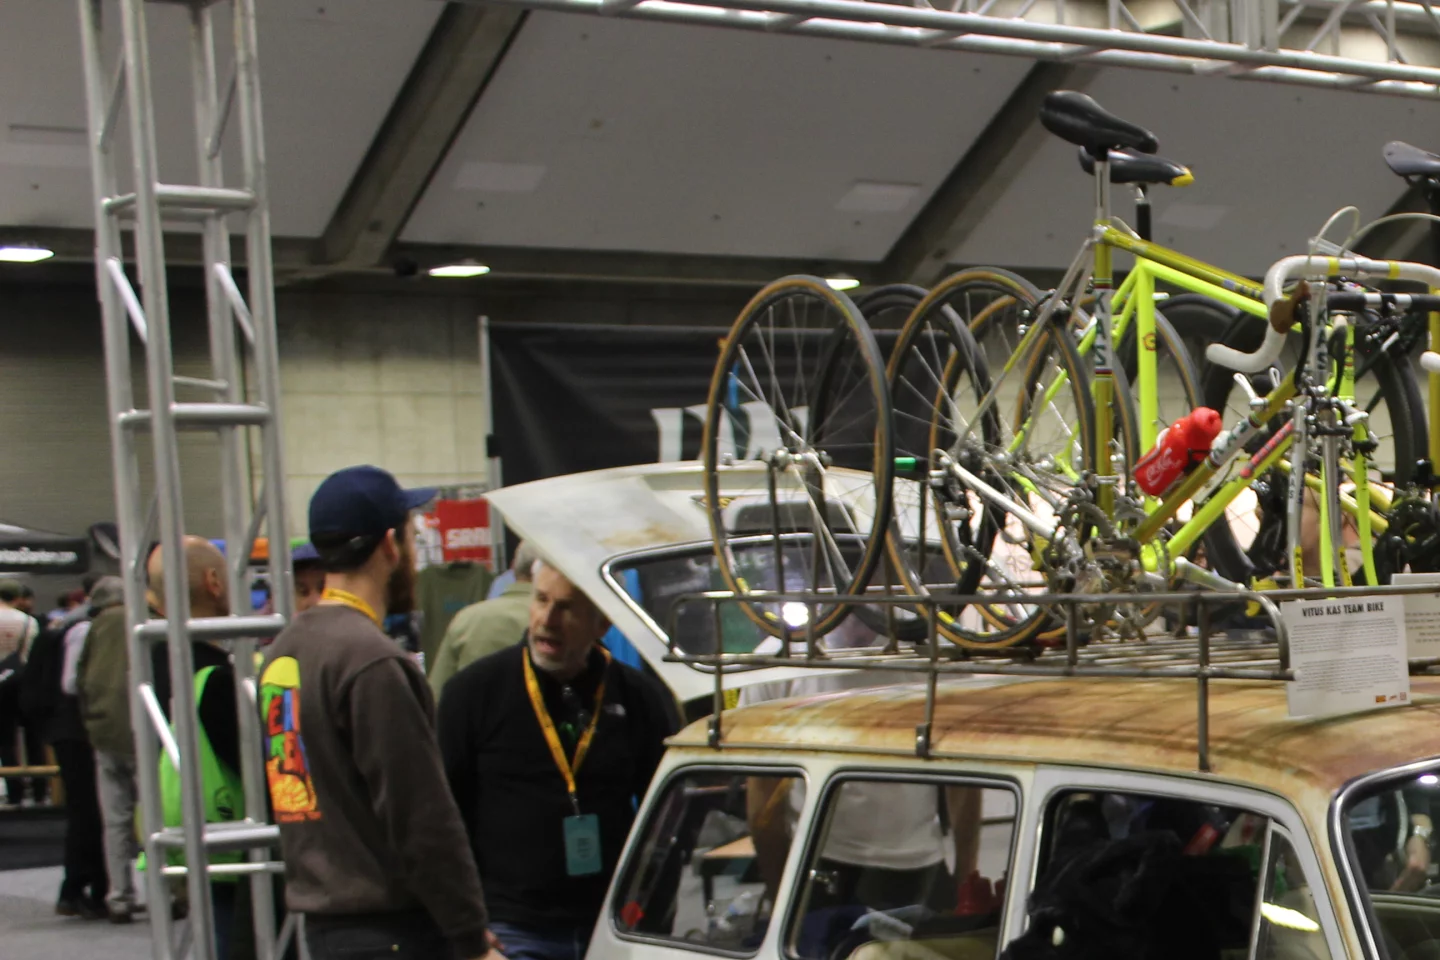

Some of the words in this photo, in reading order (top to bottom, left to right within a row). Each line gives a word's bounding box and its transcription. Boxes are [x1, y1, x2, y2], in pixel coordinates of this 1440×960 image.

[1302, 606, 1324, 617] VITUS
[1326, 605, 1342, 616] KAS
[1343, 603, 1365, 615] TEAM
[1367, 602, 1385, 612] BIKE
